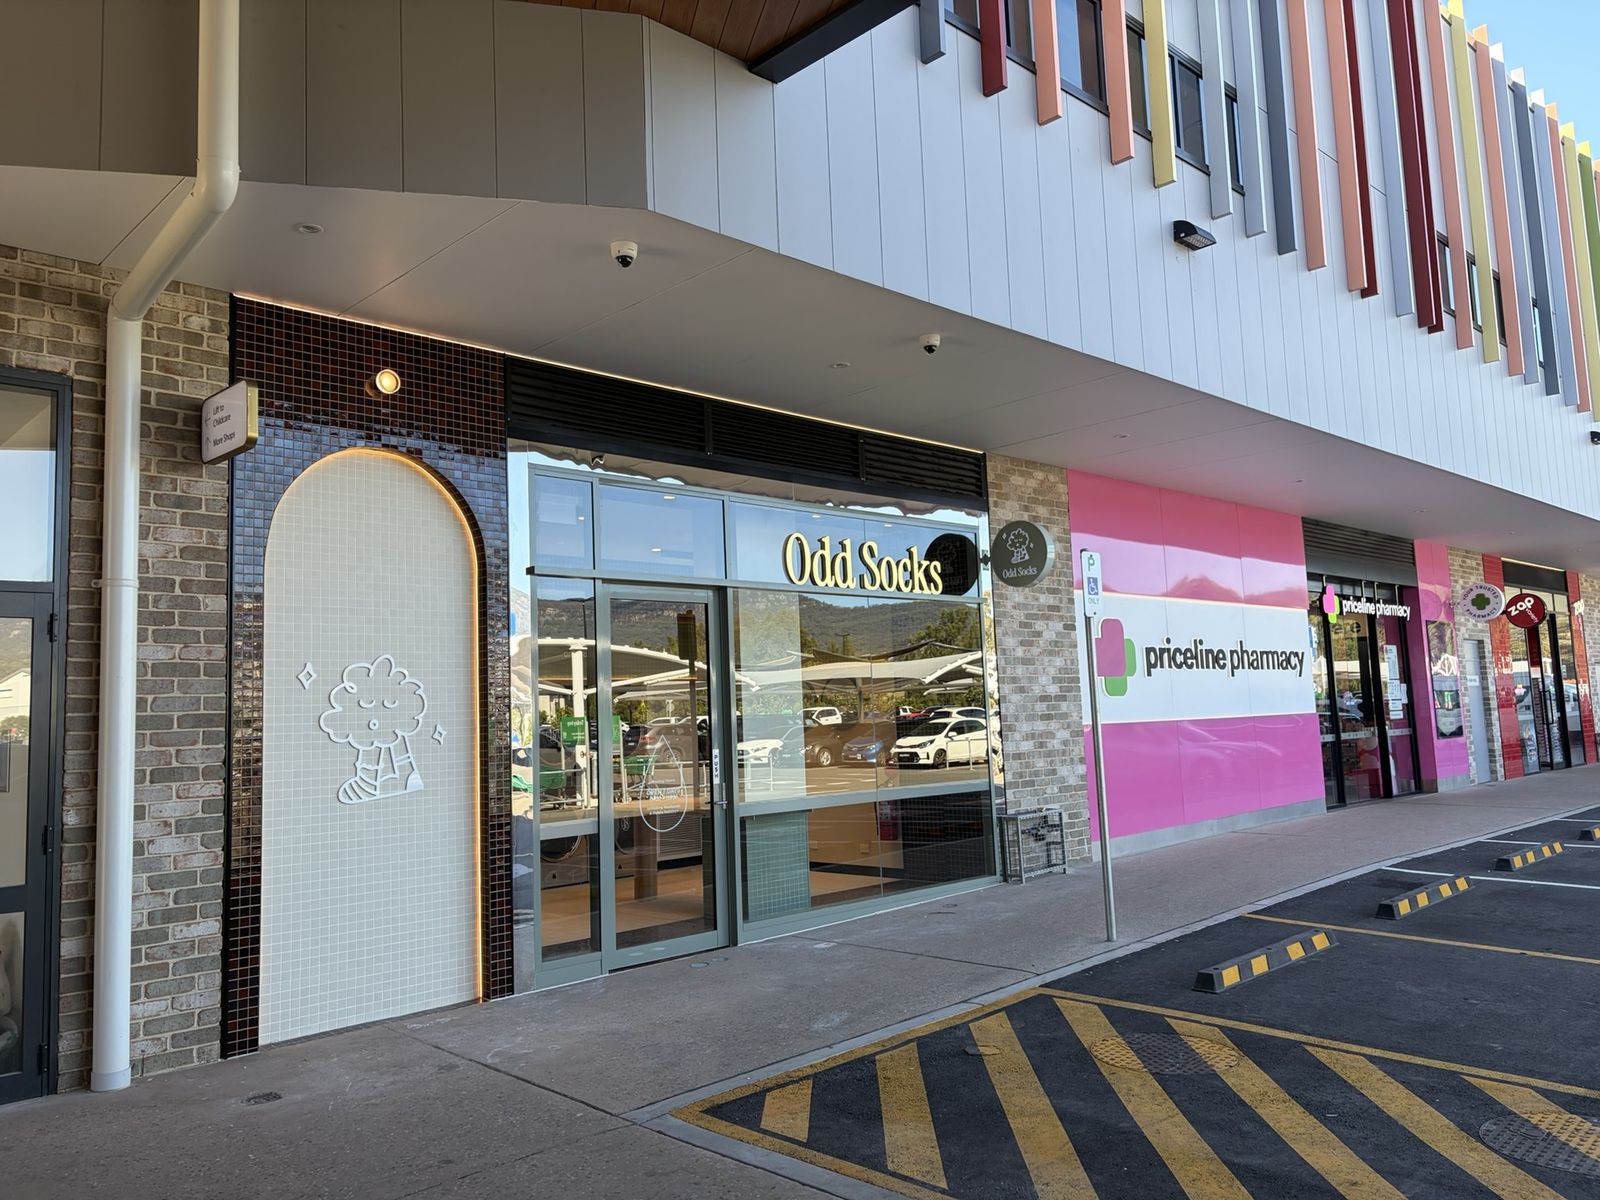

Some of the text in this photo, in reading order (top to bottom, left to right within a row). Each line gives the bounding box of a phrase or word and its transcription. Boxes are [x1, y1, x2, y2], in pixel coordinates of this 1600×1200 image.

[783, 532, 943, 595] Odd Socks
[1002, 565, 1038, 578] Odd Socks
[1087, 556, 1095, 572] P
[1463, 585, 1499, 600] YOUR TRUSTED
[1342, 596, 1411, 621] priceline pharmacy
[1466, 607, 1497, 618] PHARMACY
[1507, 597, 1534, 616] zap
[1145, 637, 1305, 677] priceline pharmacy
